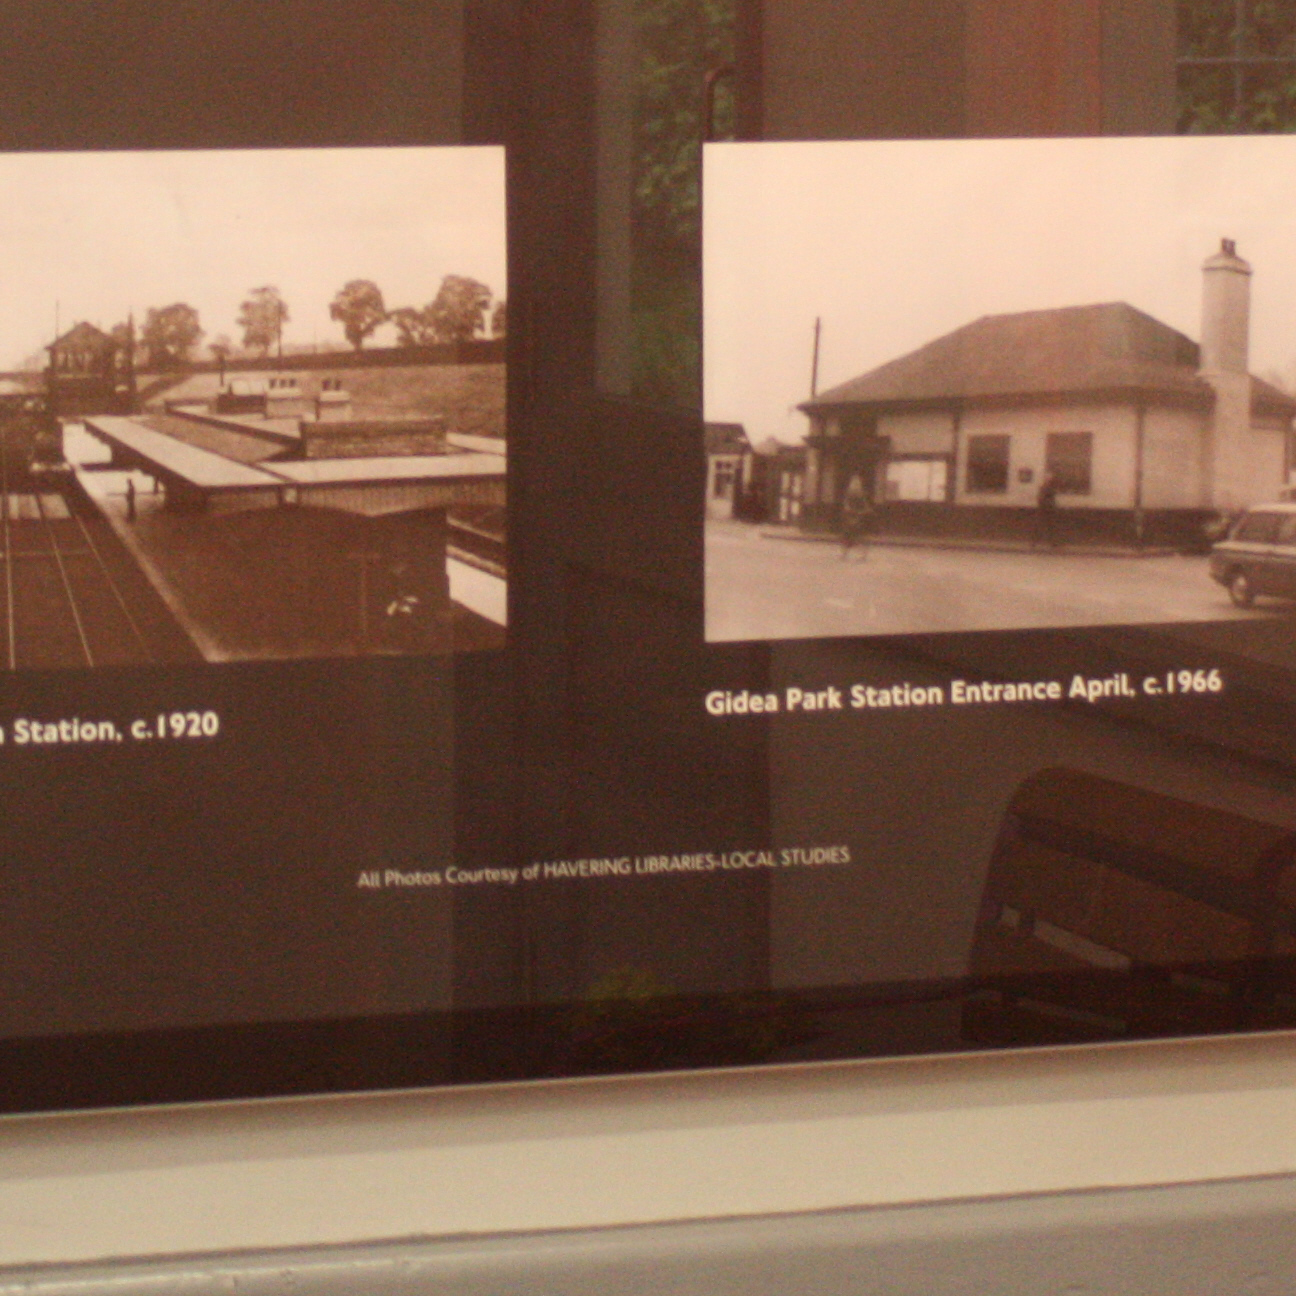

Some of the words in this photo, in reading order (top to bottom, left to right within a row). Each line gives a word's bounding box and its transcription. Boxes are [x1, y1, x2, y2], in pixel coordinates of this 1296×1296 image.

[704, 689, 779, 716] Gidea
[786, 685, 843, 711] Park
[850, 682, 944, 709] Station
[950, 679, 1062, 705] Entrance
[1068, 673, 1136, 703] April,
[1142, 668, 1223, 695] c.1966
[13, 717, 123, 745] Station,
[130, 710, 220, 740] c.1920
[357, 871, 381, 889] All
[384, 868, 443, 887] Photos
[444, 865, 519, 885] Courtesy
[521, 863, 541, 881] of
[543, 857, 632, 879] HAVERING
[780, 845, 851, 867] STUDIES
